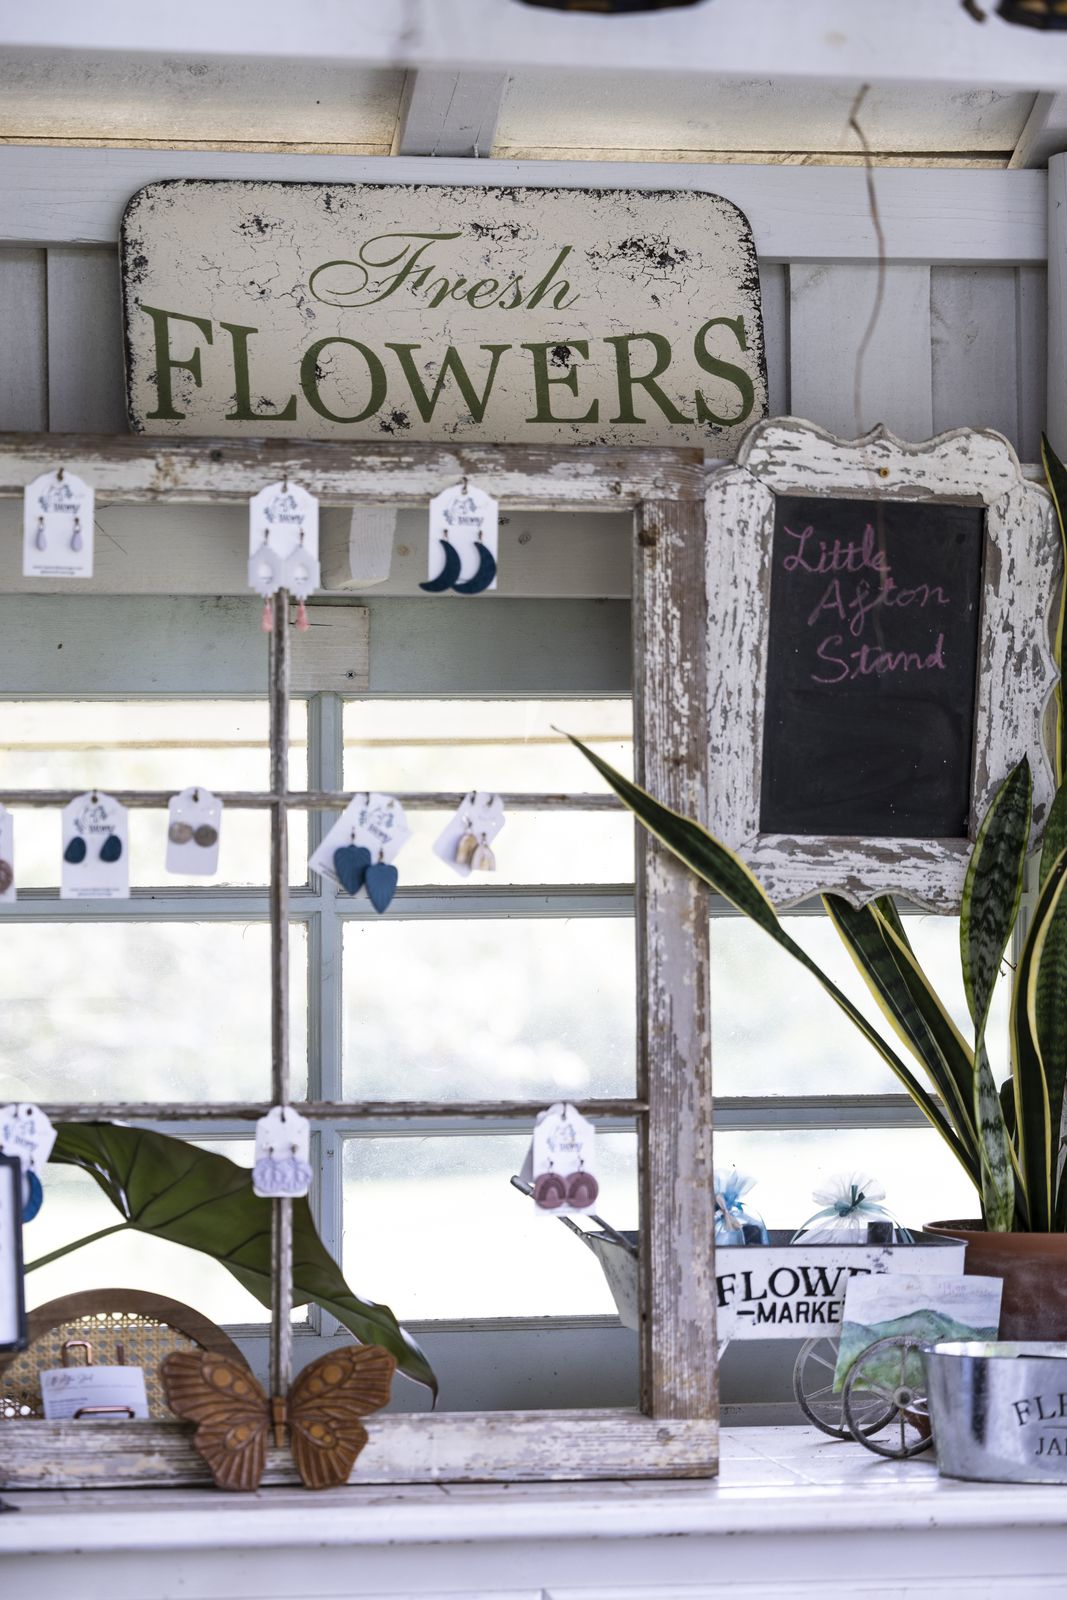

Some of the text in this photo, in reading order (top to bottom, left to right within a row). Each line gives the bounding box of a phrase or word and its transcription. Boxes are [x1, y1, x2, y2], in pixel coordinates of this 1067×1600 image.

[308, 231, 581, 310] Fresh
[141, 304, 756, 427] FLOWERS
[783, 523, 892, 573] Little
[807, 576, 950, 636] Afton
[811, 632, 947, 684] Stand
[716, 1266, 889, 1307] FLOW
[757, 1301, 846, 1324] MARKE
